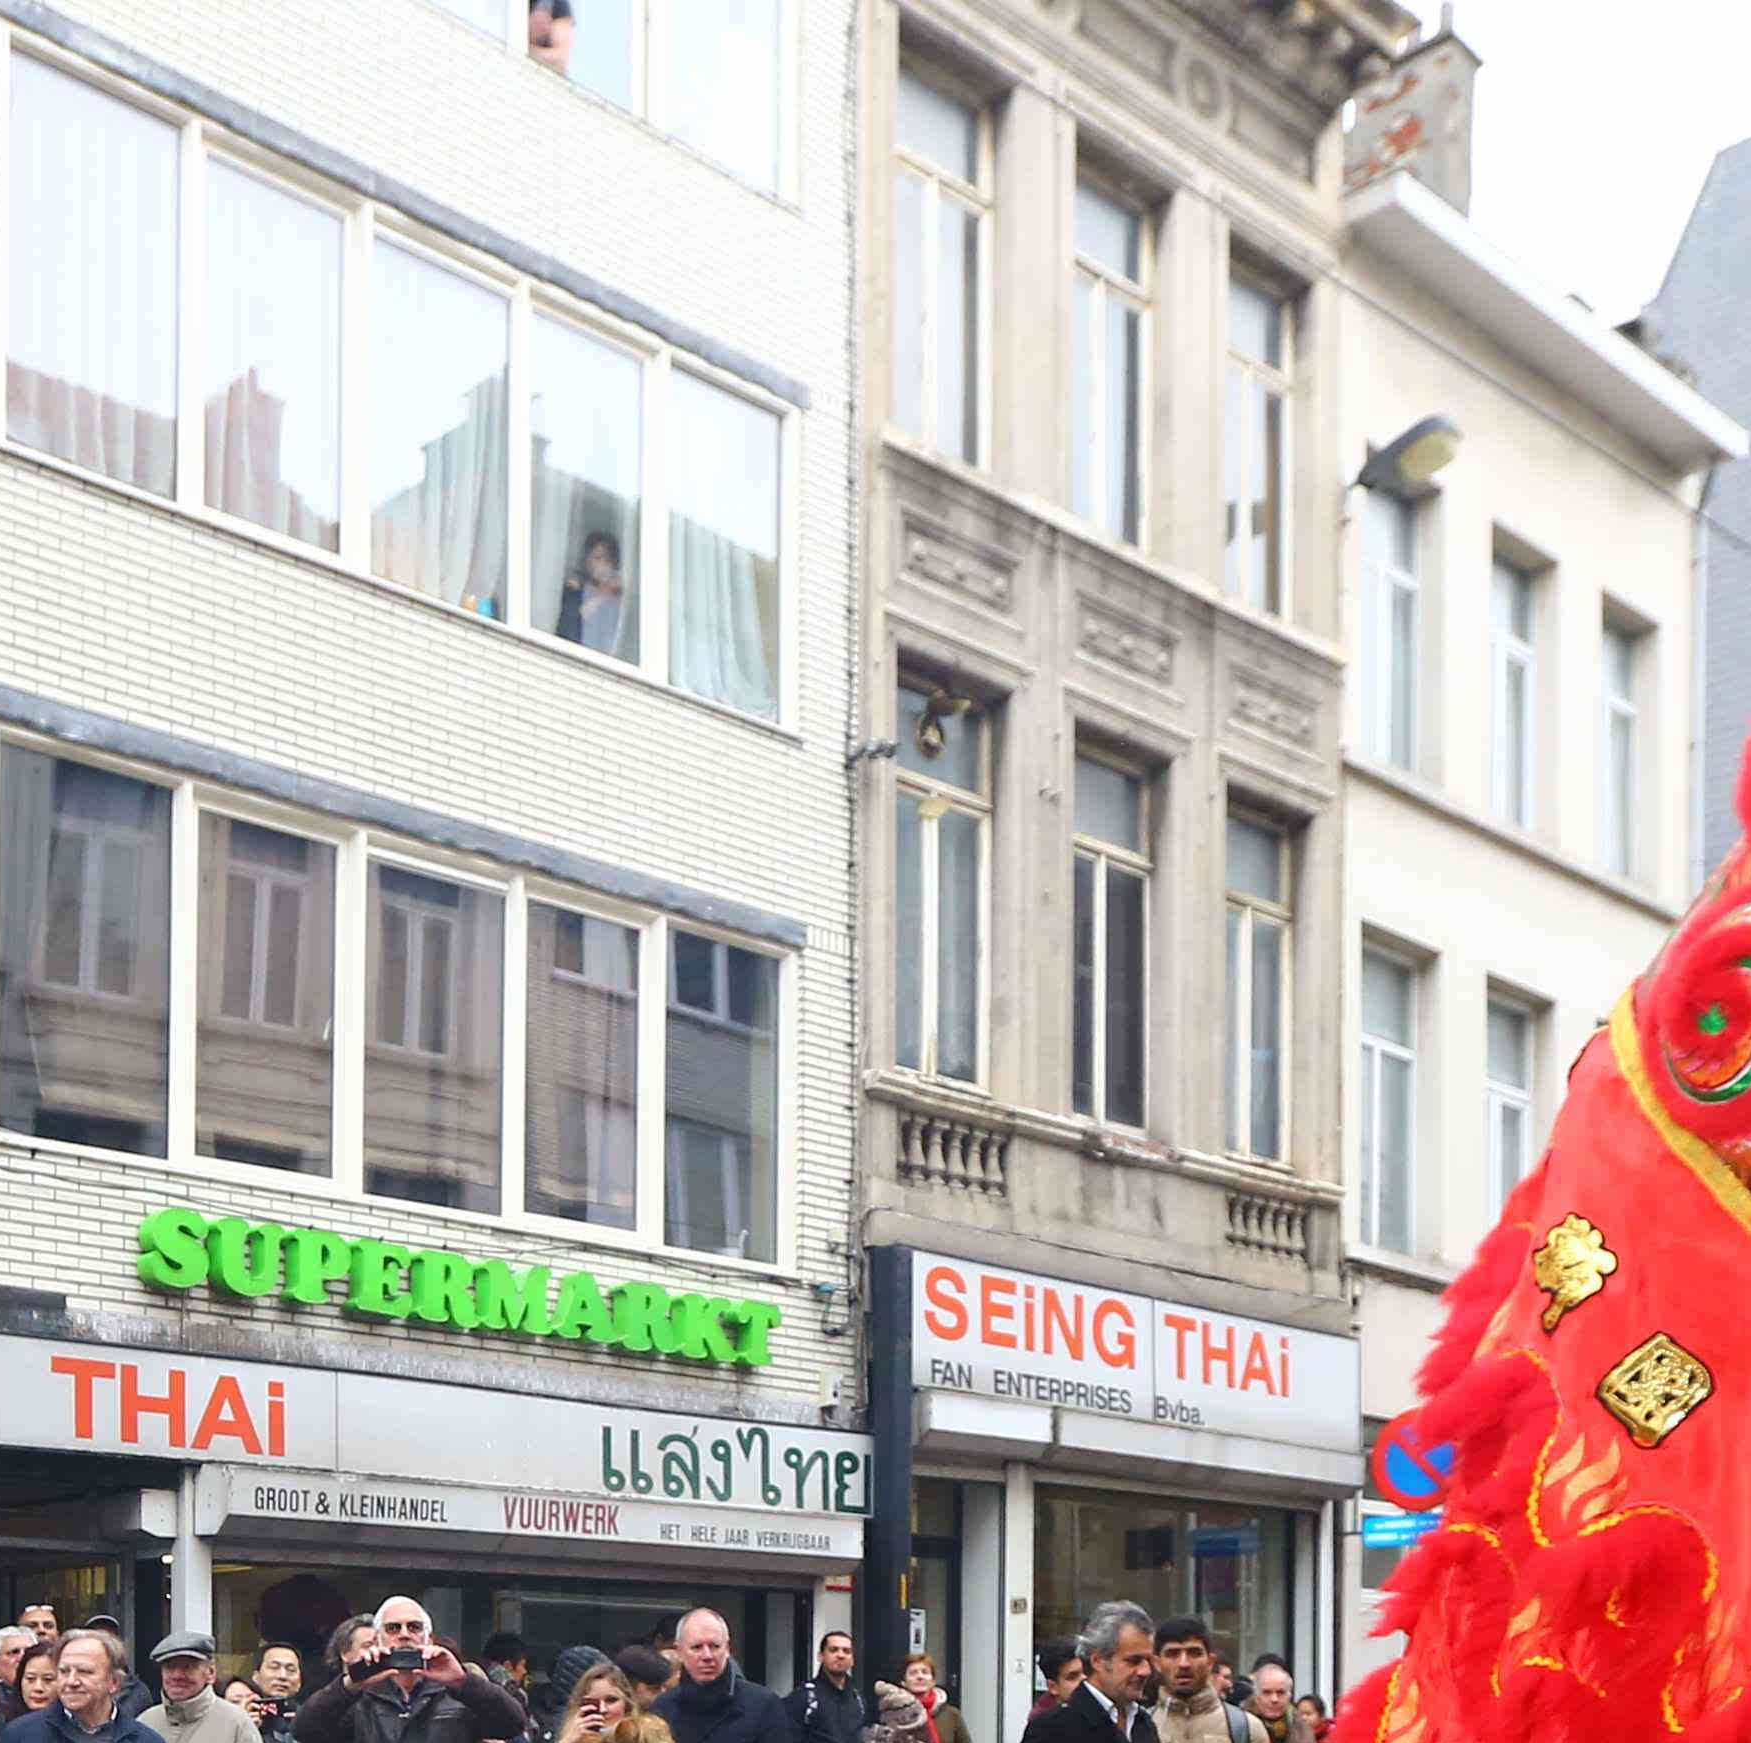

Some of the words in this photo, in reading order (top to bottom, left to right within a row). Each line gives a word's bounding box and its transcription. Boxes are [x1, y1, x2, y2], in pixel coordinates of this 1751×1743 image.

[137, 1206, 782, 1367] SUPERMARKT
[930, 1358, 973, 1390] FAN
[993, 1369, 1133, 1414] ENTERPRISES
[254, 1486, 311, 1513] GROOT
[314, 1491, 331, 1515] &
[339, 1492, 449, 1523] KLEINHANDEL
[503, 1495, 620, 1536] VUURWERK
[659, 1523, 681, 1541] HET
[691, 1524, 717, 1543] HELE
[724, 1529, 750, 1546] JAAR
